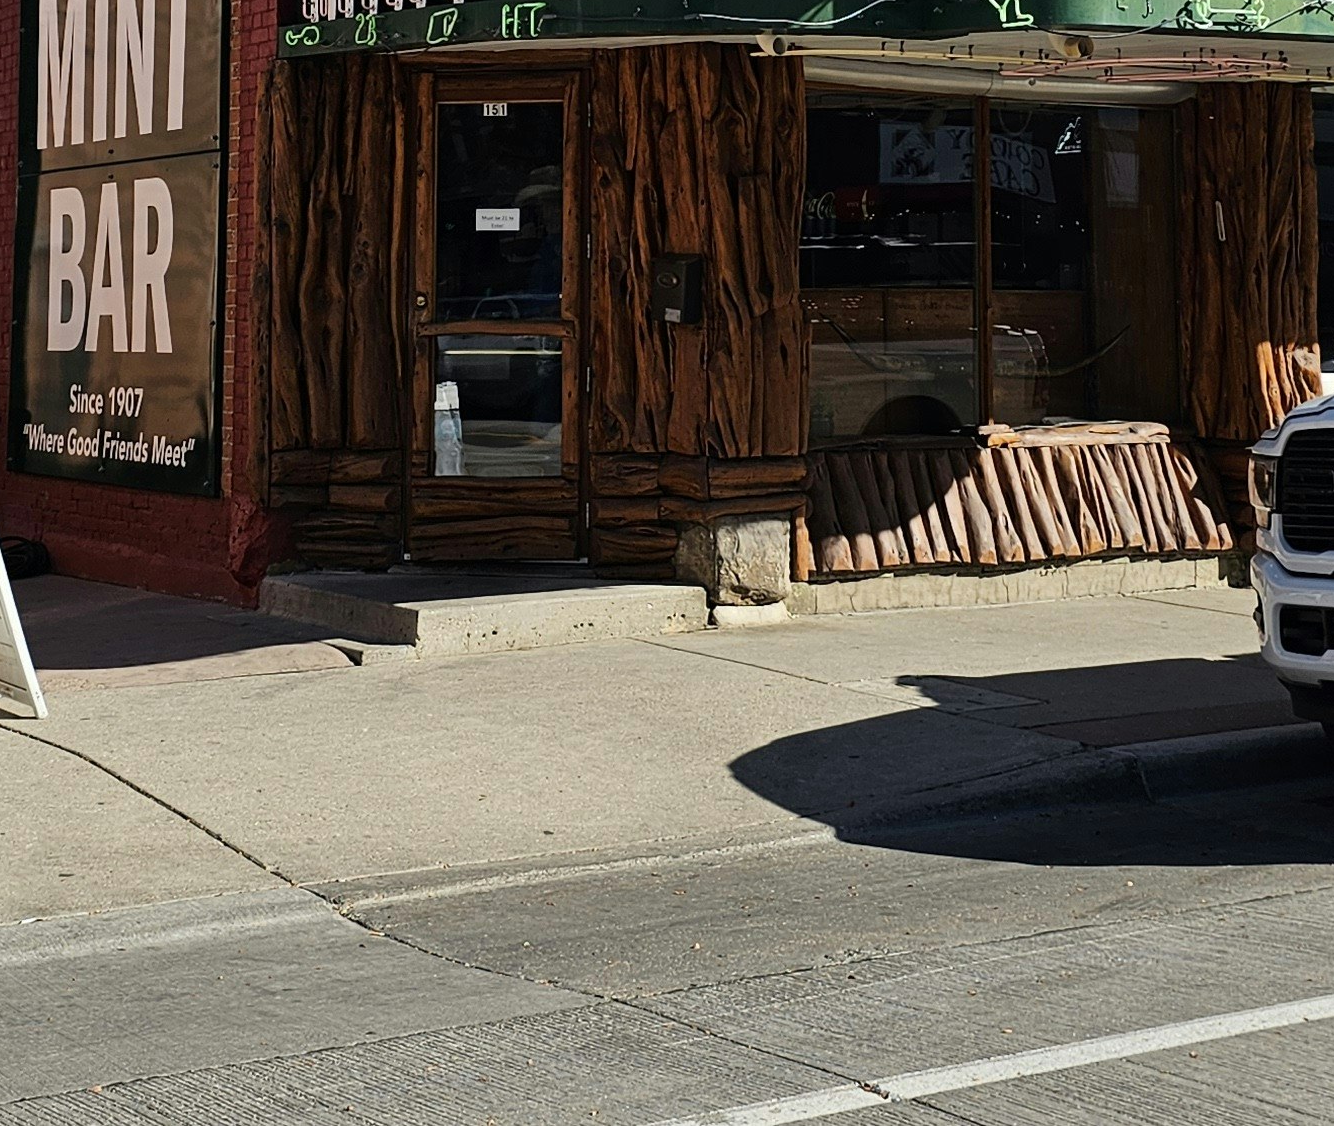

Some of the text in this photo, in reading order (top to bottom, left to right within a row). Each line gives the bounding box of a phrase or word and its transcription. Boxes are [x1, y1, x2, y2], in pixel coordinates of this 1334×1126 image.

[485, 104, 505, 116] 151
[47, 176, 174, 353] BAR
[69, 384, 144, 418] Since 1907
[23, 423, 65, 454] "Where
[67, 427, 101, 458] Good
[102, 430, 149, 463] Friends
